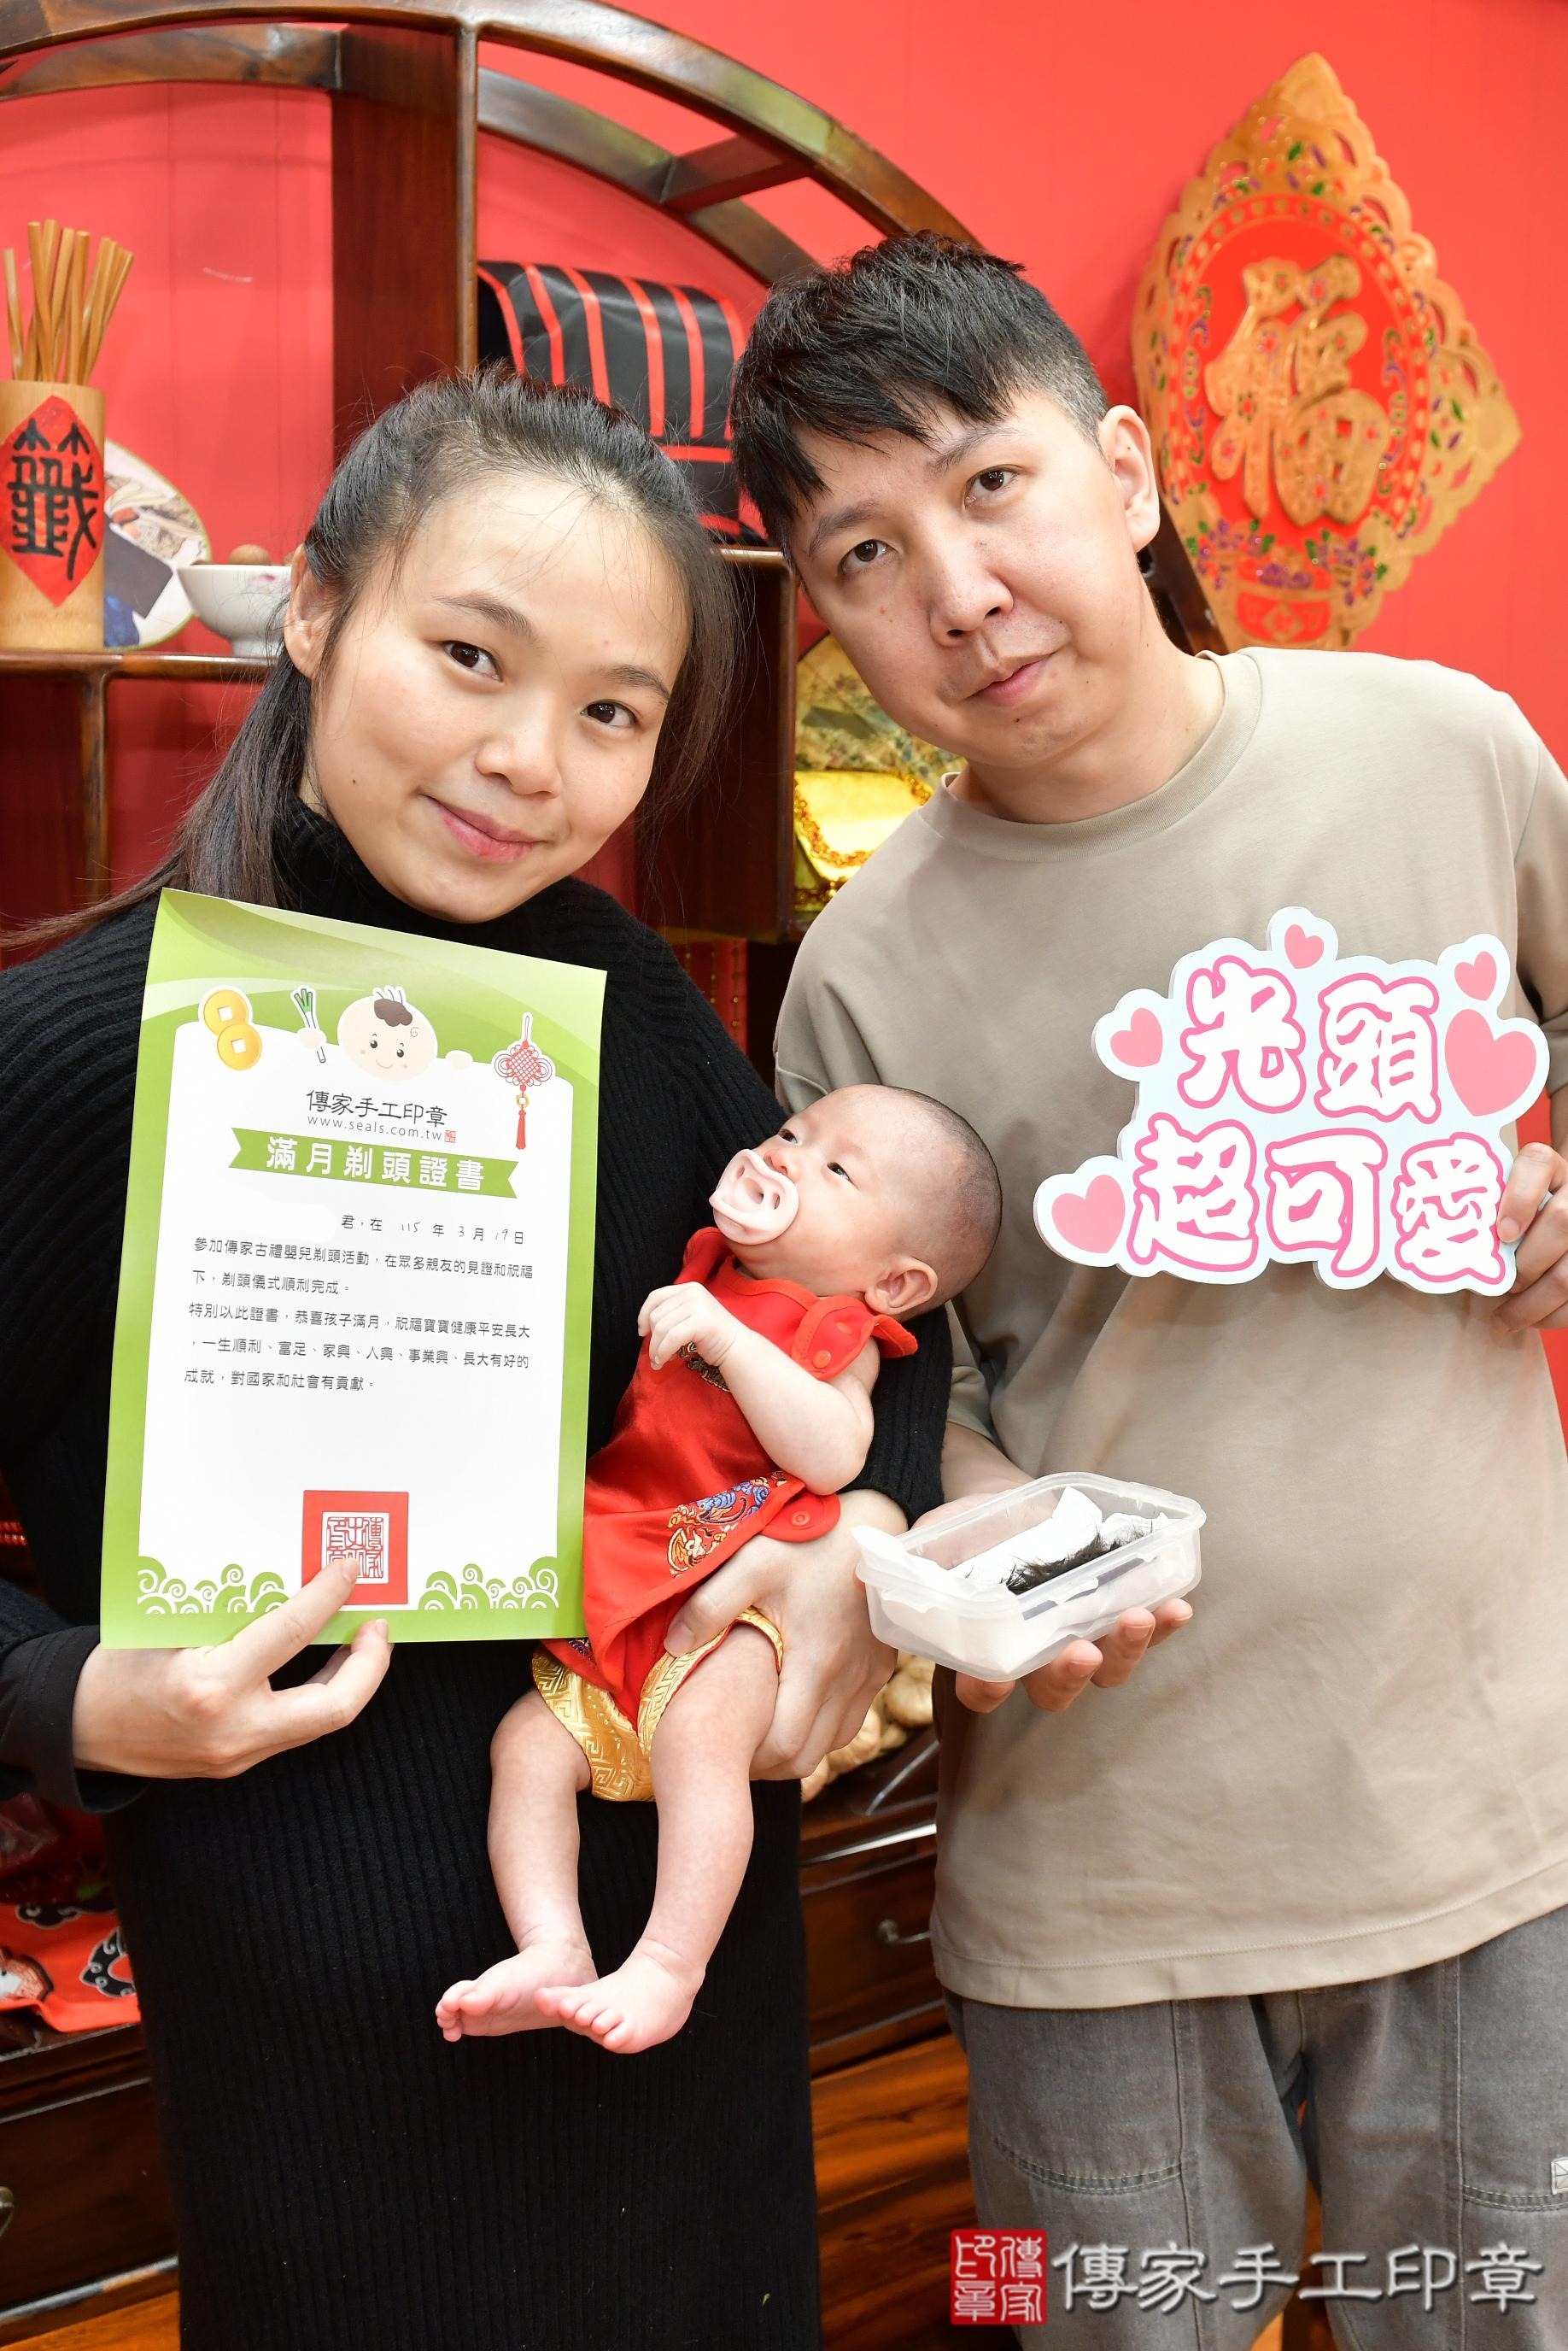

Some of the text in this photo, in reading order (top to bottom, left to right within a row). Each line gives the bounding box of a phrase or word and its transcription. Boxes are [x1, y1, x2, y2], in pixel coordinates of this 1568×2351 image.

[1204, 253, 1390, 527] 福
[1177, 954, 1442, 1125] 光頭
[306, 1089, 448, 1128] 傳家手工印章
[307, 1116, 442, 1140] www.seals.com.tw
[266, 1135, 484, 1191] 滿月剃頭證書
[1126, 1111, 1507, 1285] 超可愛
[431, 1222, 445, 1238] 年
[459, 1225, 465, 1237] 3
[472, 1228, 484, 1241] 月
